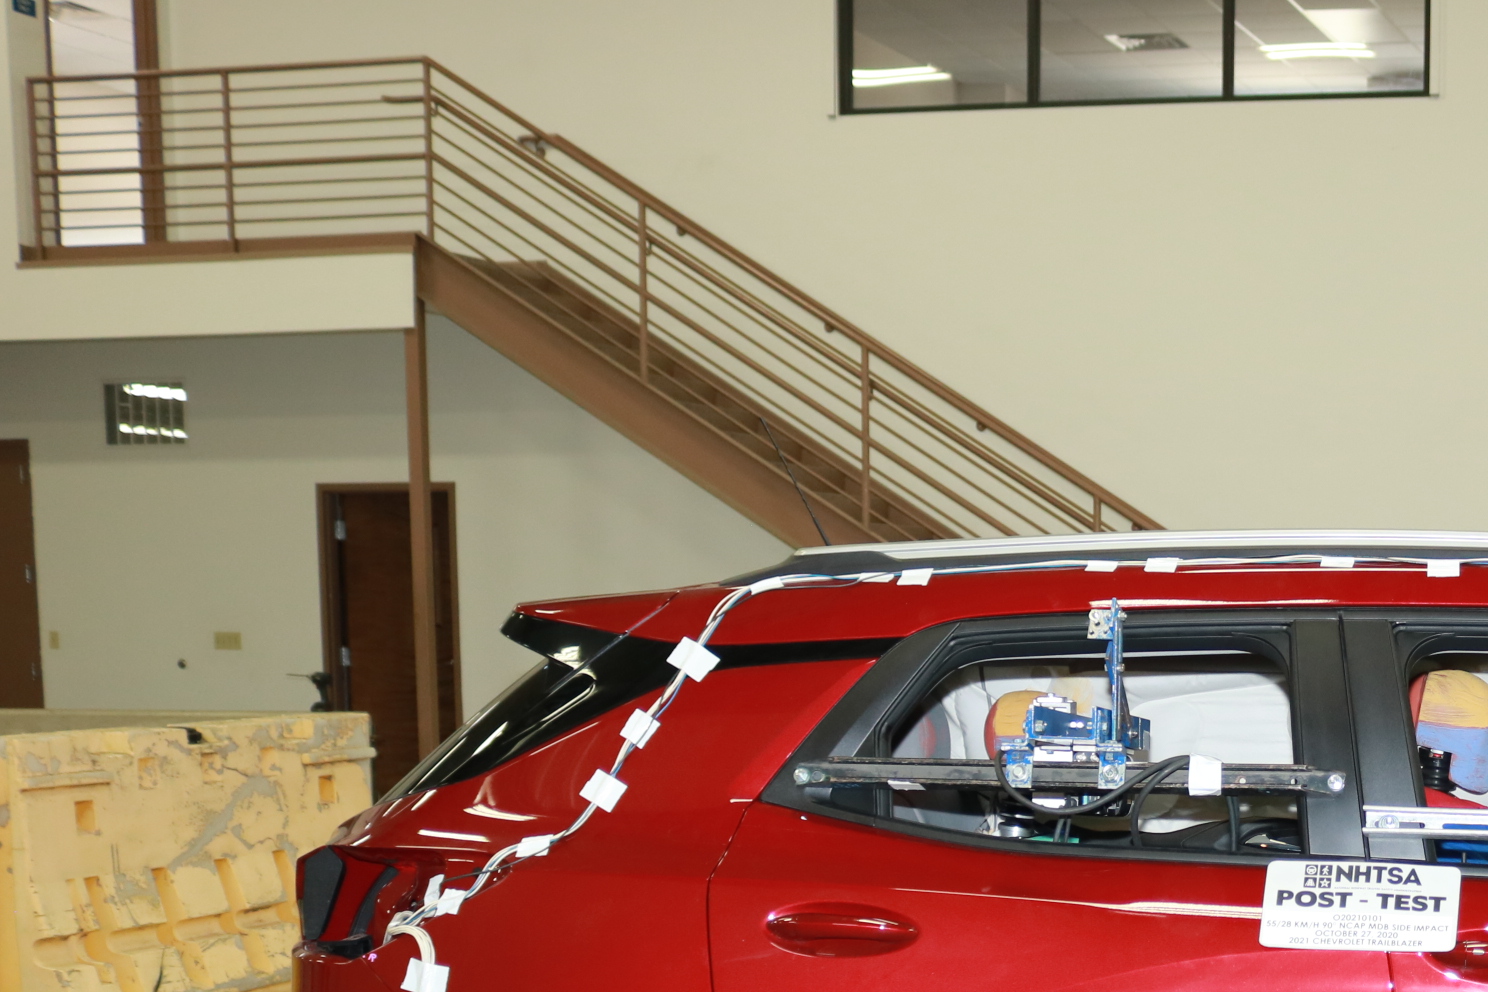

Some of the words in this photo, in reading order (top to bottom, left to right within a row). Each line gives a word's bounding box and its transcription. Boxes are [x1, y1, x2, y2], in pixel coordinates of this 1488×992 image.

[1335, 865, 1422, 886] NHTSA
[1276, 890, 1353, 908] POST
[1376, 893, 1447, 913] TEST
[1266, 920, 1292, 928] 55/28
[1294, 921, 1319, 929] KM/H
[1313, 938, 1365, 946] CHEVROLET
[1368, 939, 1423, 947] TRAILBLAZER
